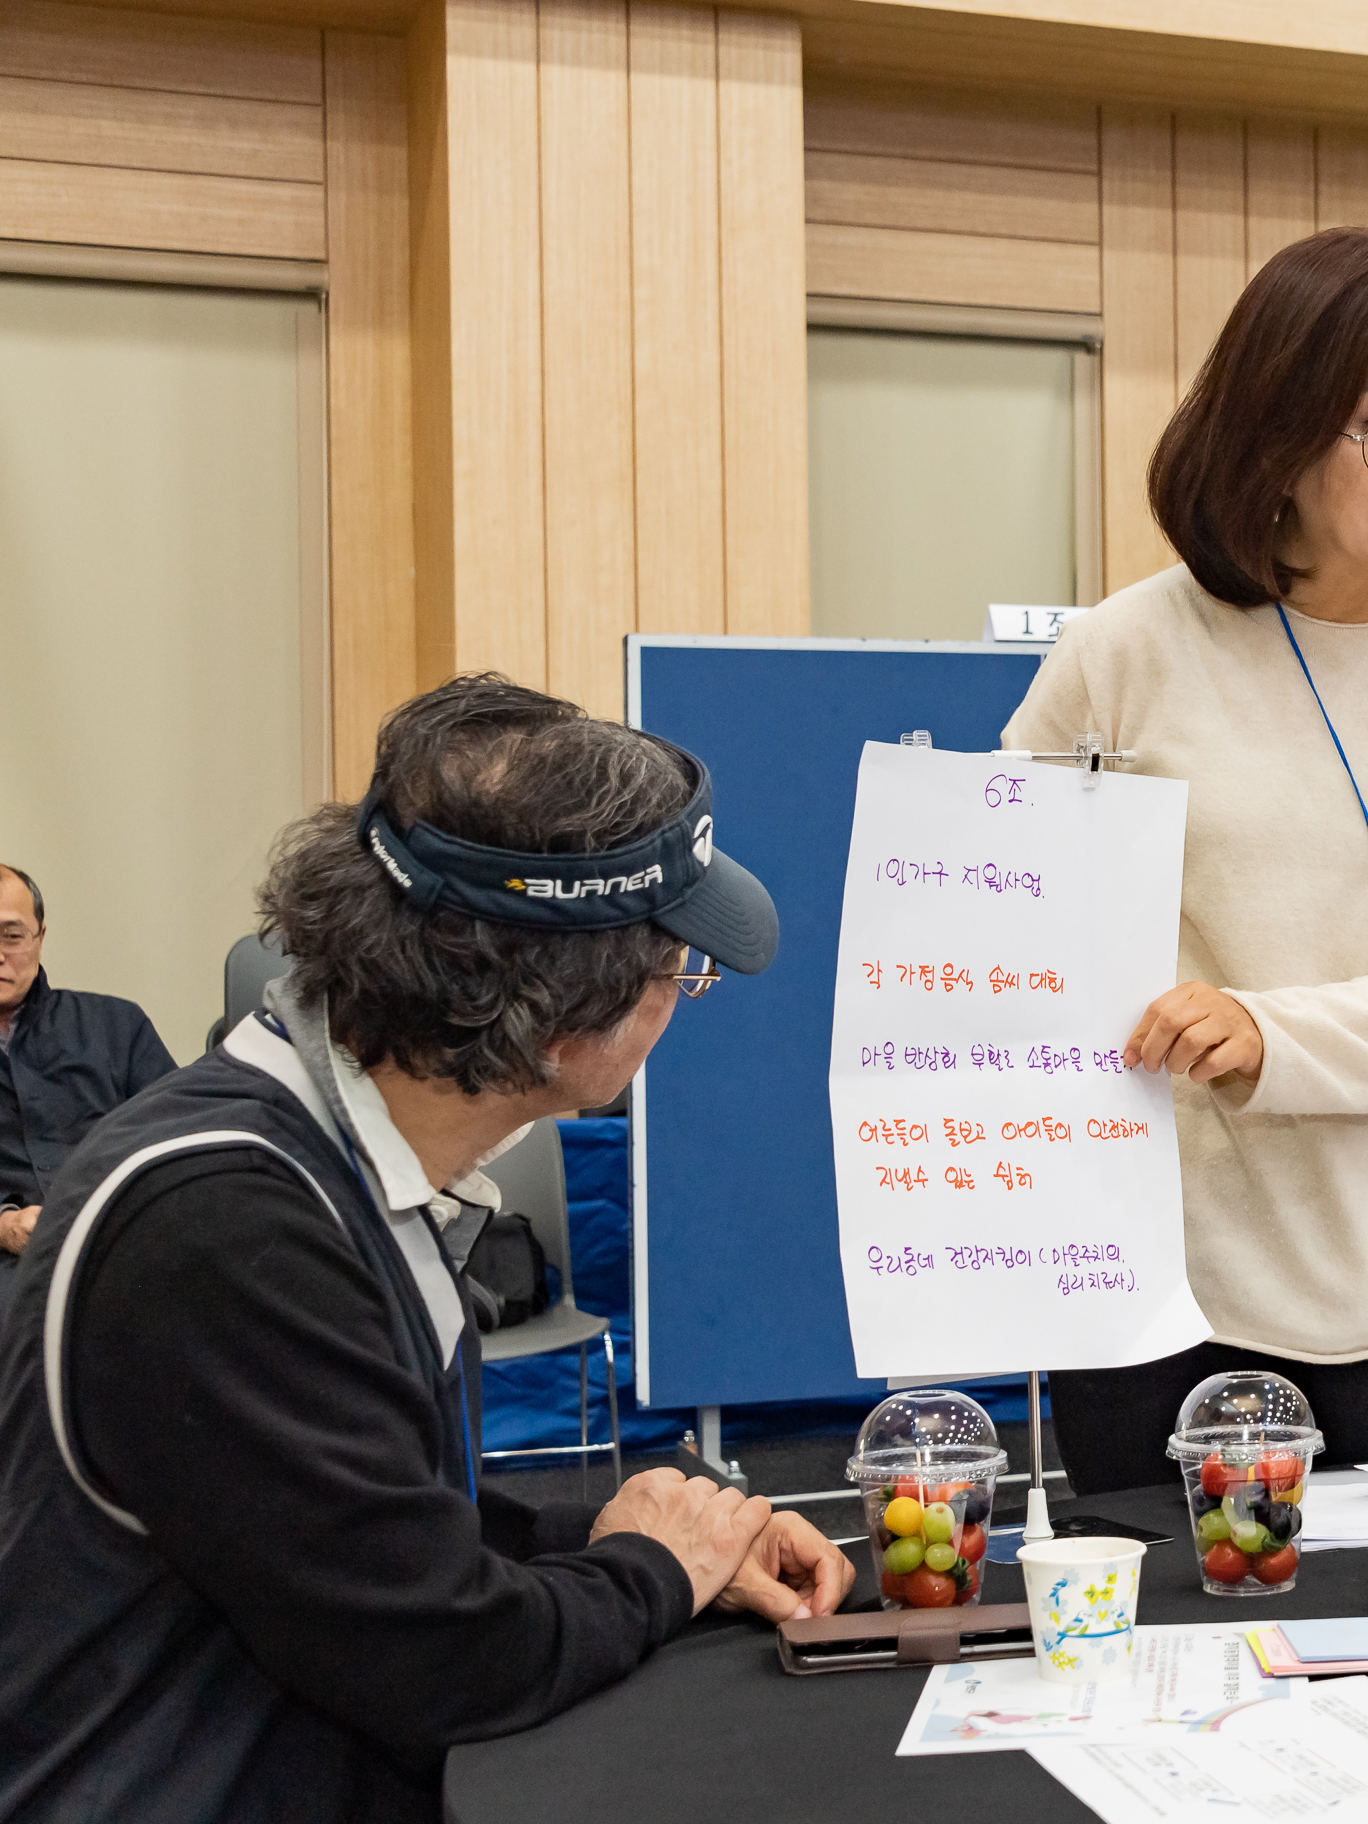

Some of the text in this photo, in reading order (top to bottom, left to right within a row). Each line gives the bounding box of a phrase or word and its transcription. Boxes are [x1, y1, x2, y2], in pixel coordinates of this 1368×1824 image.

[524, 863, 664, 899] BURNER
[862, 960, 884, 990] 각
[988, 964, 1021, 994] 솜씨
[1029, 969, 1065, 995] 대회
[861, 1041, 896, 1071] 마을
[904, 1045, 957, 1072] 반상회
[1026, 1045, 1084, 1075] 소통마을
[858, 1118, 929, 1147] 어른들이
[1001, 1116, 1072, 1143] 아이들이
[1086, 1118, 1149, 1140] 안전하게
[944, 1166, 976, 1190] 있는
[867, 1245, 935, 1277] 우리동네
